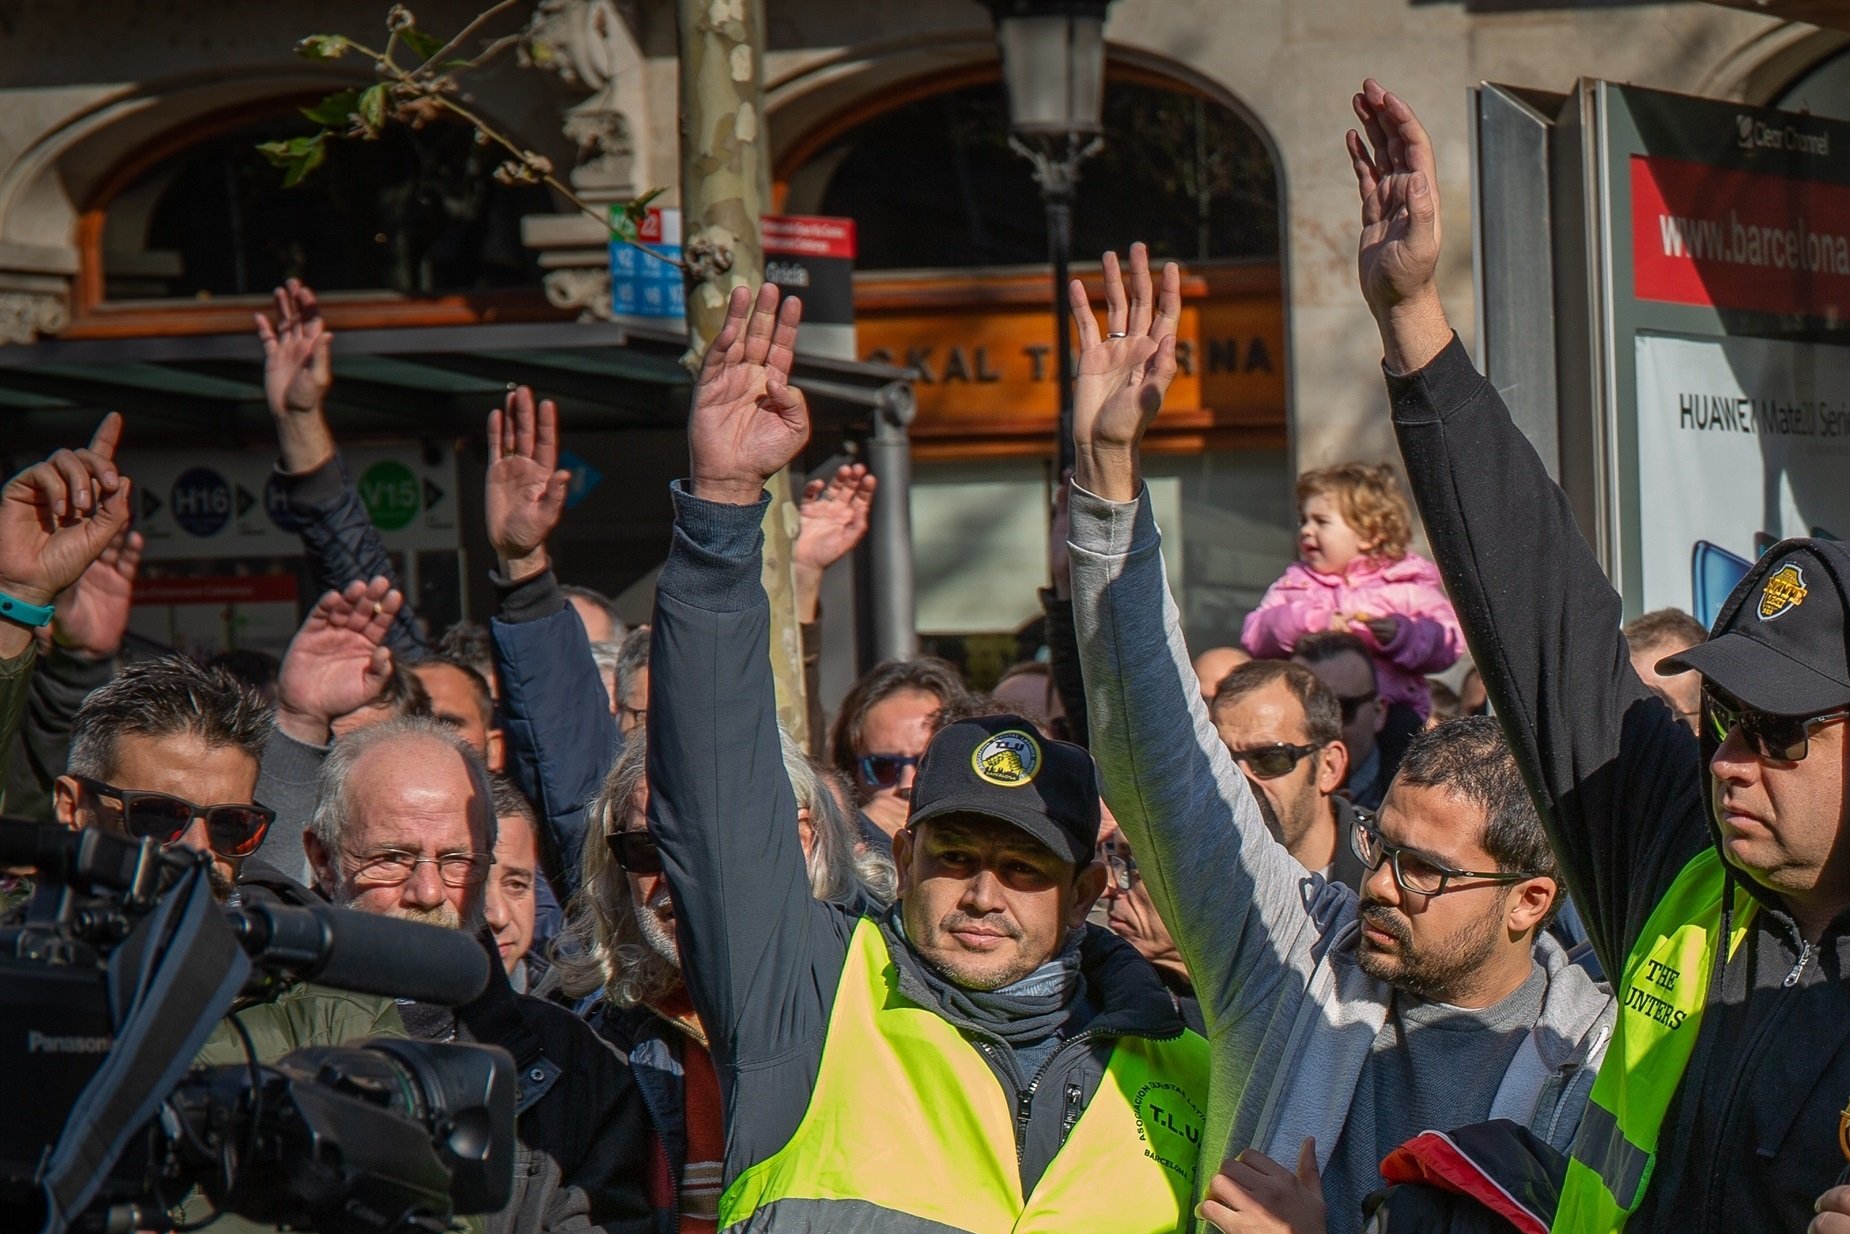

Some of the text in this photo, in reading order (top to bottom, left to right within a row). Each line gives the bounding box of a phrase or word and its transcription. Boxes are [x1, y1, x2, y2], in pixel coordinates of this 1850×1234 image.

[1753, 121, 1830, 155] Clear Channel
[1680, 393, 1758, 434] HUAWEI
[173, 485, 230, 517] H16
[363, 482, 415, 513] V15
[1645, 959, 1681, 992] THE
